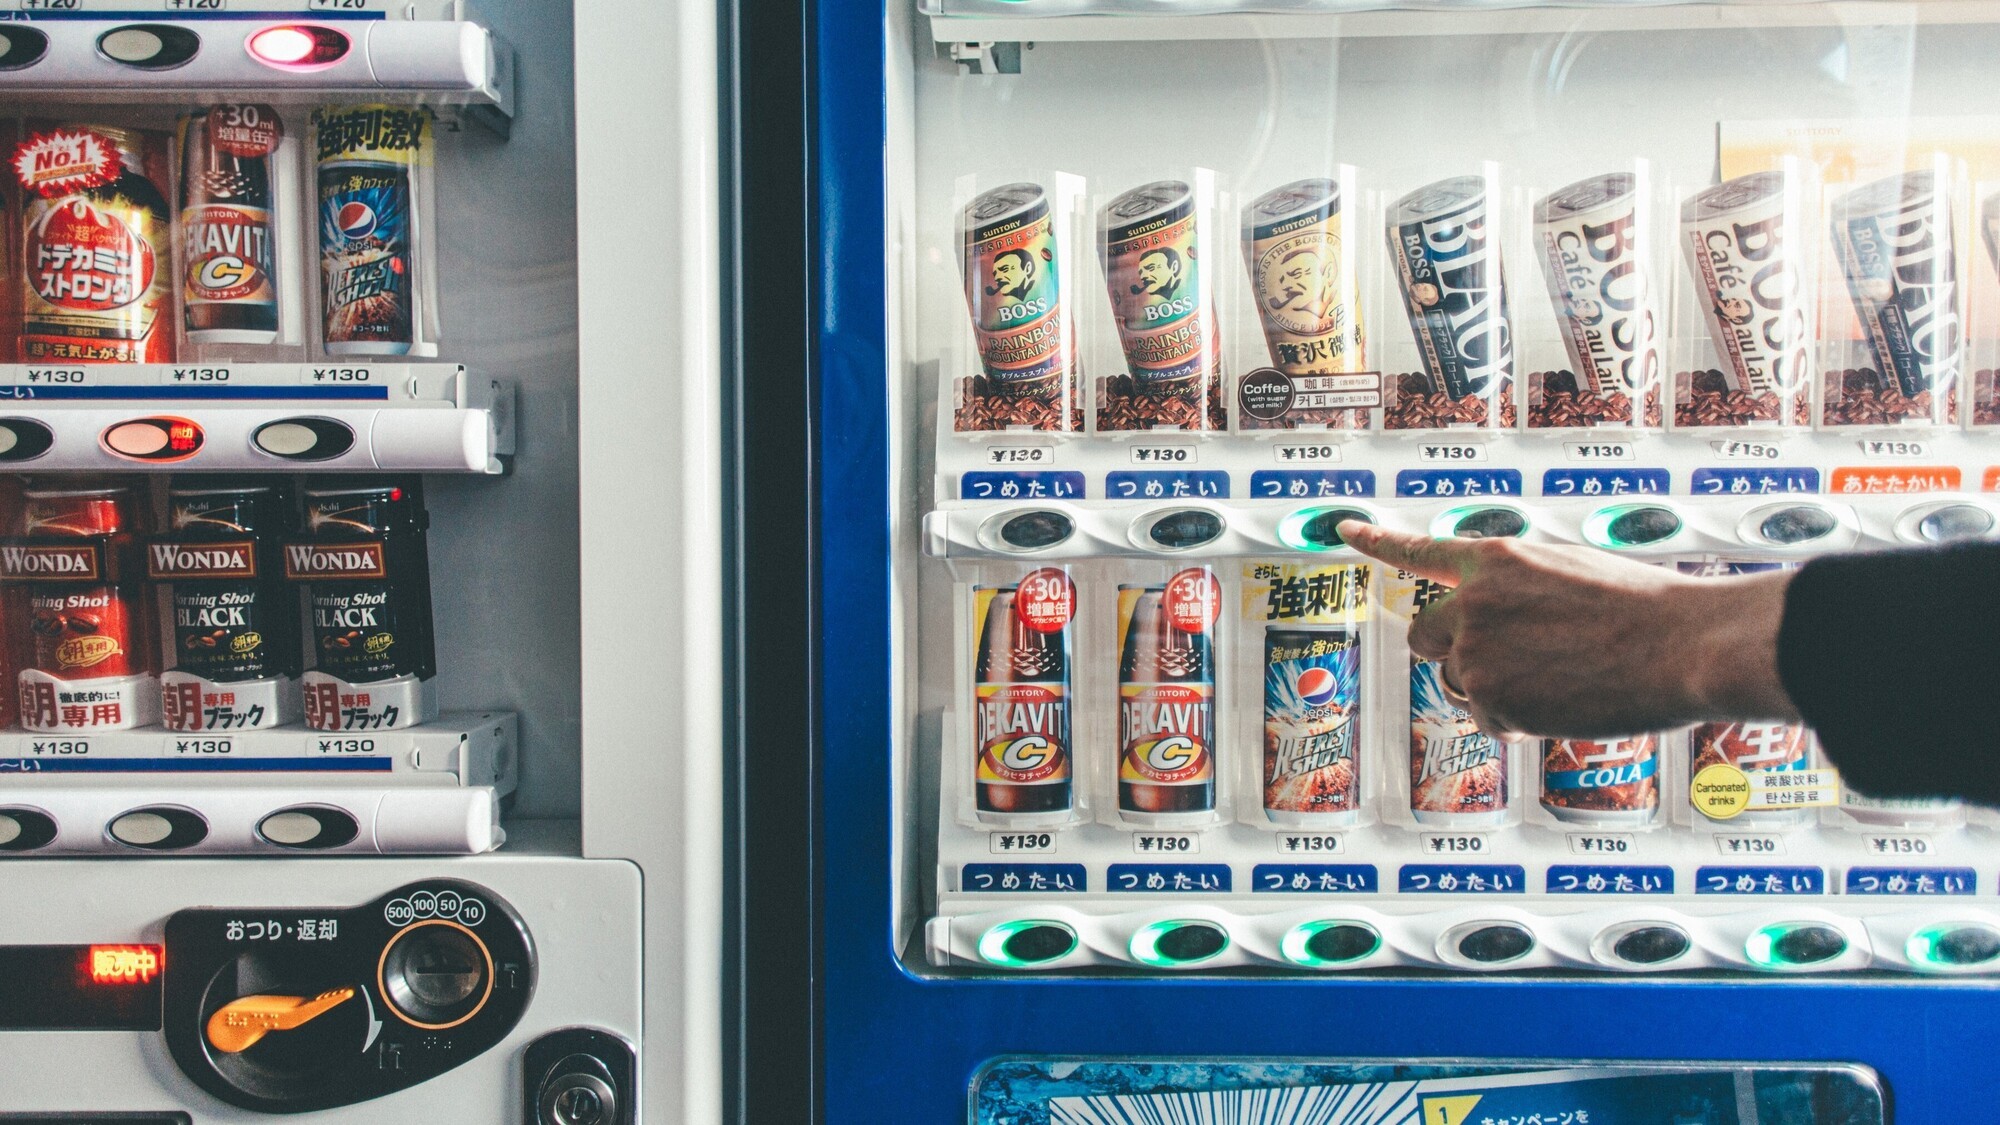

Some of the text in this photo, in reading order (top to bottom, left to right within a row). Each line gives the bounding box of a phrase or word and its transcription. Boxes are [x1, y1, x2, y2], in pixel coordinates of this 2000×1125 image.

[35, 139, 87, 172] No.1
[1269, 243, 1292, 260] THE
[1404, 233, 1431, 279] BOSS
[1854, 227, 1884, 273] BOSS
[37, 243, 133, 275] ドデカミン
[201, 256, 244, 289] C
[1557, 231, 1595, 289] Café
[1585, 329, 1605, 353] au
[1706, 230, 1746, 289] Café
[1736, 328, 1756, 356] au
[1874, 202, 1959, 392] BLACK
[998, 297, 1047, 322] BOSS
[1144, 296, 1193, 321] BOSS
[1422, 209, 1514, 400] BLACK
[1275, 313, 1306, 331] SINCE
[1135, 317, 1201, 351] RAINBO
[28, 370, 84, 383] ¥130
[174, 368, 229, 381] ¥130
[313, 368, 369, 381] ¥130
[1244, 384, 1289, 395] Coffee
[992, 449, 1043, 463] ¥130
[1136, 448, 1187, 461] ¥130
[1282, 446, 1333, 459] ¥130
[1425, 446, 1477, 459] ¥130
[1577, 445, 1624, 458] ¥130
[1727, 442, 1779, 459] ¥130
[1870, 442, 1922, 455] ¥130
[973, 480, 1073, 498] つめたい
[1118, 480, 1218, 497] つめたい
[1263, 479, 1363, 496] つめたい
[1408, 478, 1509, 495] つめたい
[1554, 478, 1657, 495] つめたい
[1703, 476, 1806, 494] つめたい
[1842, 476, 1949, 493] あたたかい
[1254, 566, 1281, 579] さらに
[67, 595, 110, 608] Shot
[351, 592, 387, 605] Shot
[1267, 566, 1370, 621] 強刺激
[178, 607, 246, 627] BLACK
[315, 607, 378, 628] BLACK
[1027, 602, 1067, 617] 増量缶
[162, 682, 203, 730] 朝
[203, 693, 235, 706] 専用
[303, 682, 341, 730] 朝
[341, 694, 371, 707] 専用
[61, 703, 121, 728] 専用
[204, 704, 264, 730] ブラック
[341, 705, 399, 730] ブラック
[1302, 708, 1333, 719] pepsi
[33, 742, 89, 755] ¥130
[176, 741, 231, 754] ¥130
[319, 740, 374, 753] ¥130
[1003, 736, 1048, 770] C
[1147, 736, 1193, 770] C
[1288, 747, 1340, 779] SHOT
[1437, 747, 1488, 779] SHOT
[1578, 764, 1643, 788] COLA
[1764, 773, 1819, 787] 碳酸饮料
[1696, 783, 1746, 793] Carbonated
[1708, 796, 1735, 806] drinks
[1765, 791, 1820, 805] 탄산음료
[1000, 834, 1051, 850] ¥130
[1139, 836, 1190, 851] ¥130
[1286, 836, 1337, 851] ¥130
[1431, 837, 1482, 851] ¥130
[1580, 838, 1627, 852] ¥130
[1728, 838, 1775, 852] ¥130
[1873, 838, 1927, 853] ¥130
[974, 872, 1075, 890] つめたい
[1119, 872, 1220, 890] つめたい
[1264, 872, 1365, 890] つめたい
[1411, 873, 1513, 890] つめたい
[1559, 874, 1661, 891] つめたい
[1708, 873, 1811, 892] つめたい
[1859, 874, 1964, 892] つめたい
[388, 906, 411, 919] 500
[414, 899, 434, 911] 100
[440, 899, 457, 911] 50
[464, 907, 478, 919] 10
[226, 919, 338, 941] おつり・返却
[93, 951, 156, 977] 販売中
[1439, 1106, 1448, 1124] 1
